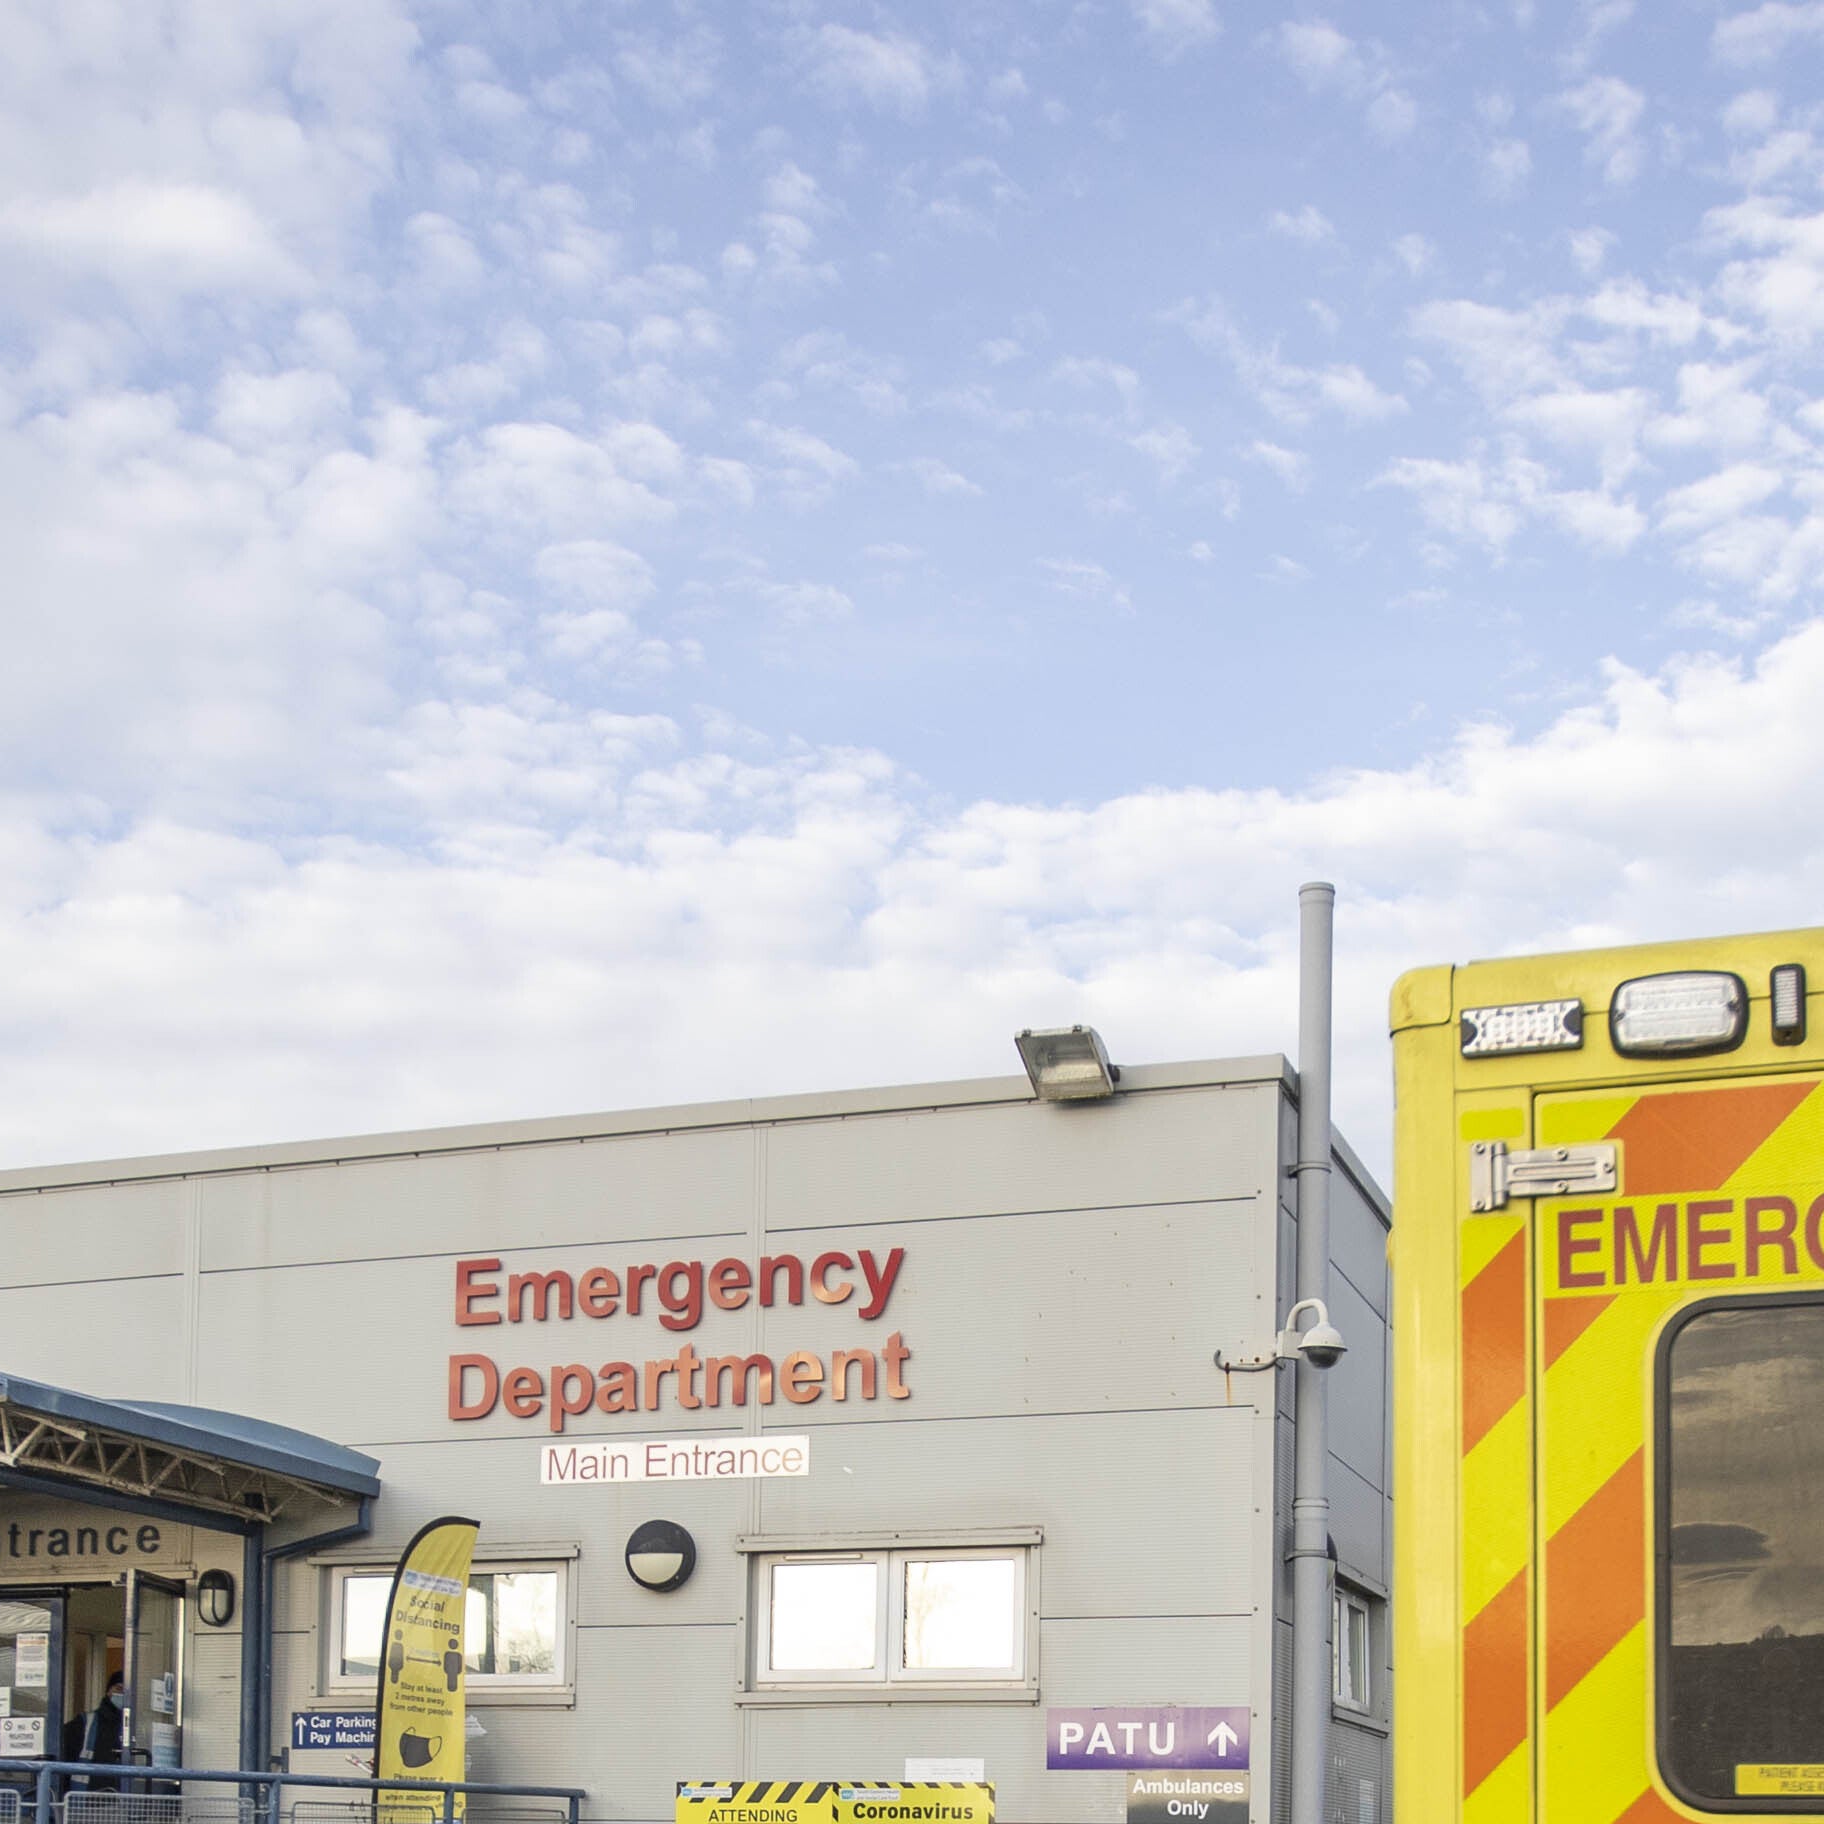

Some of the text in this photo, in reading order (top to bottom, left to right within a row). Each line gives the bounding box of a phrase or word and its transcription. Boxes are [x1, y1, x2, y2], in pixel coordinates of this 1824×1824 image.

[455, 1247, 905, 1331] Emergency
[448, 1331, 911, 1433] Department
[548, 1444, 803, 1481] Main Entrance
[409, 1595, 445, 1613] Social
[395, 1609, 461, 1635] Distancing
[310, 1716, 332, 1728] Car
[310, 1732, 332, 1745] Pay
[1059, 1721, 1175, 1756] PATU
[1133, 1779, 1244, 1794] Ambulances
[1781, 1781, 1814, 1792] PLEASE
[708, 1809, 798, 1822] ATTENDING
[853, 1803, 973, 1819] Coronavirus
[1167, 1800, 1209, 1819] Only
